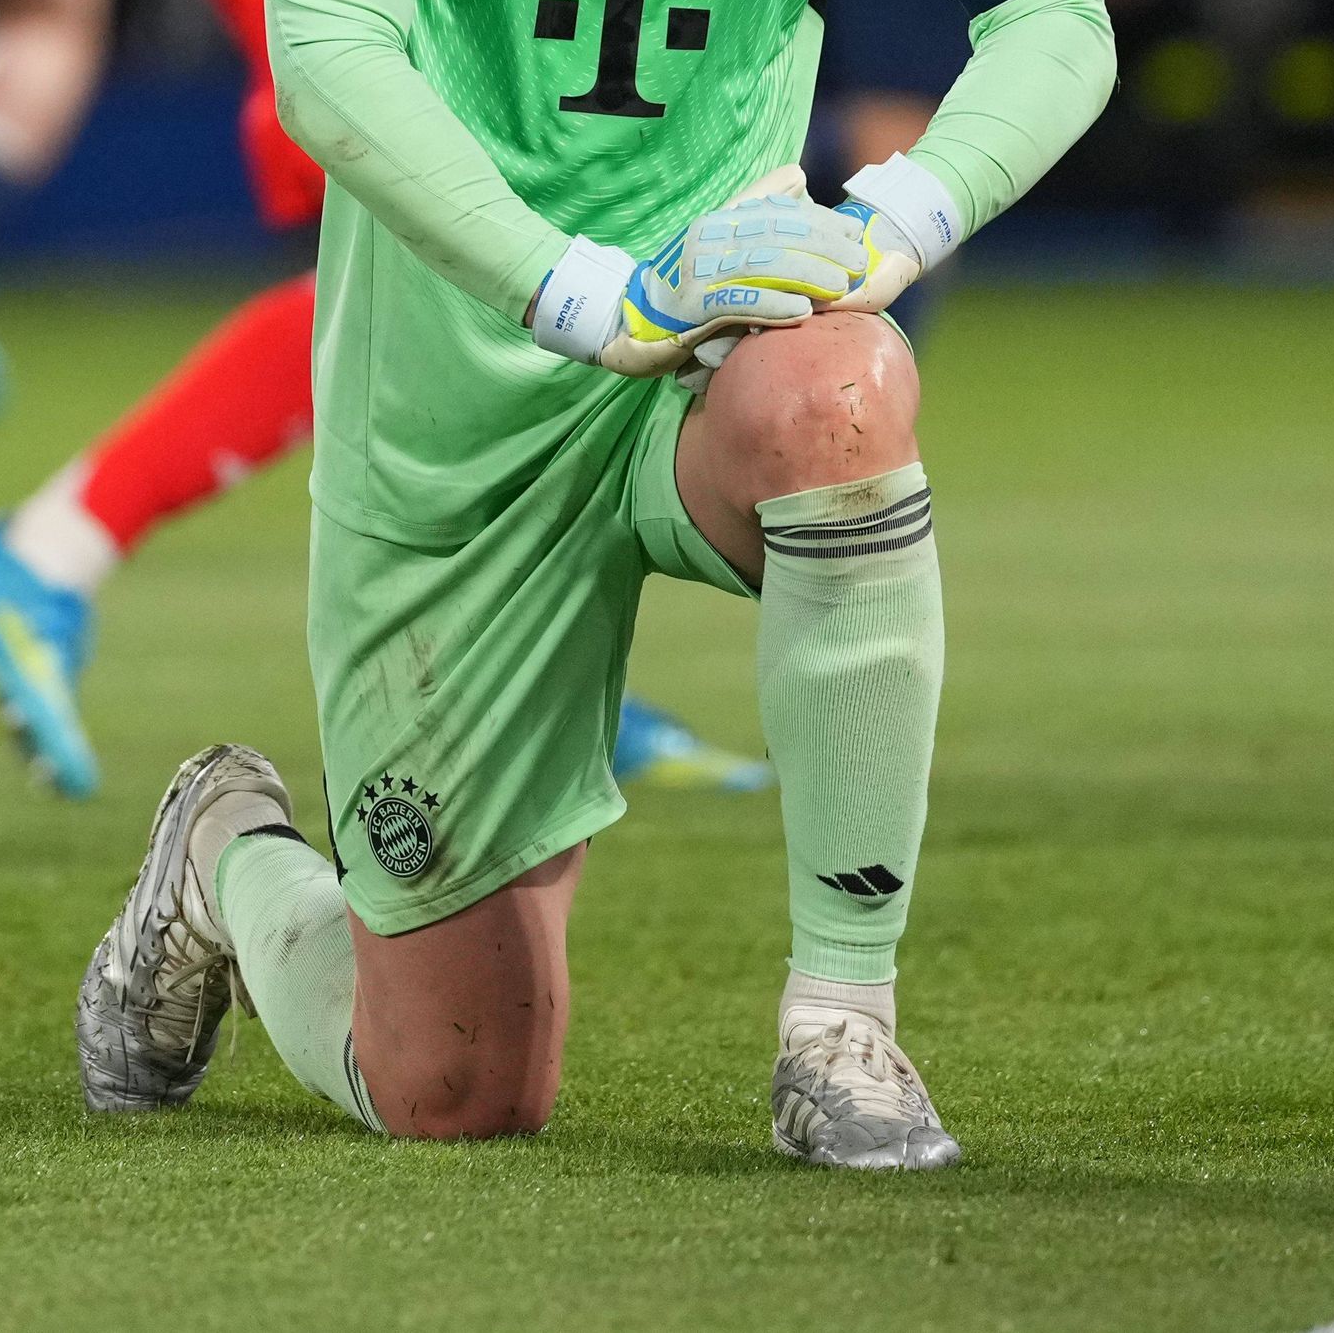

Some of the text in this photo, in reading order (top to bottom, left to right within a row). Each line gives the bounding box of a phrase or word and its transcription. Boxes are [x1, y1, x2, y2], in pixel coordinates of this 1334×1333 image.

[555, 296, 575, 330] NEUER
[563, 294, 588, 333] MANUEL
[703, 288, 760, 311] PRED
[371, 803, 423, 835] FC BAYERN
